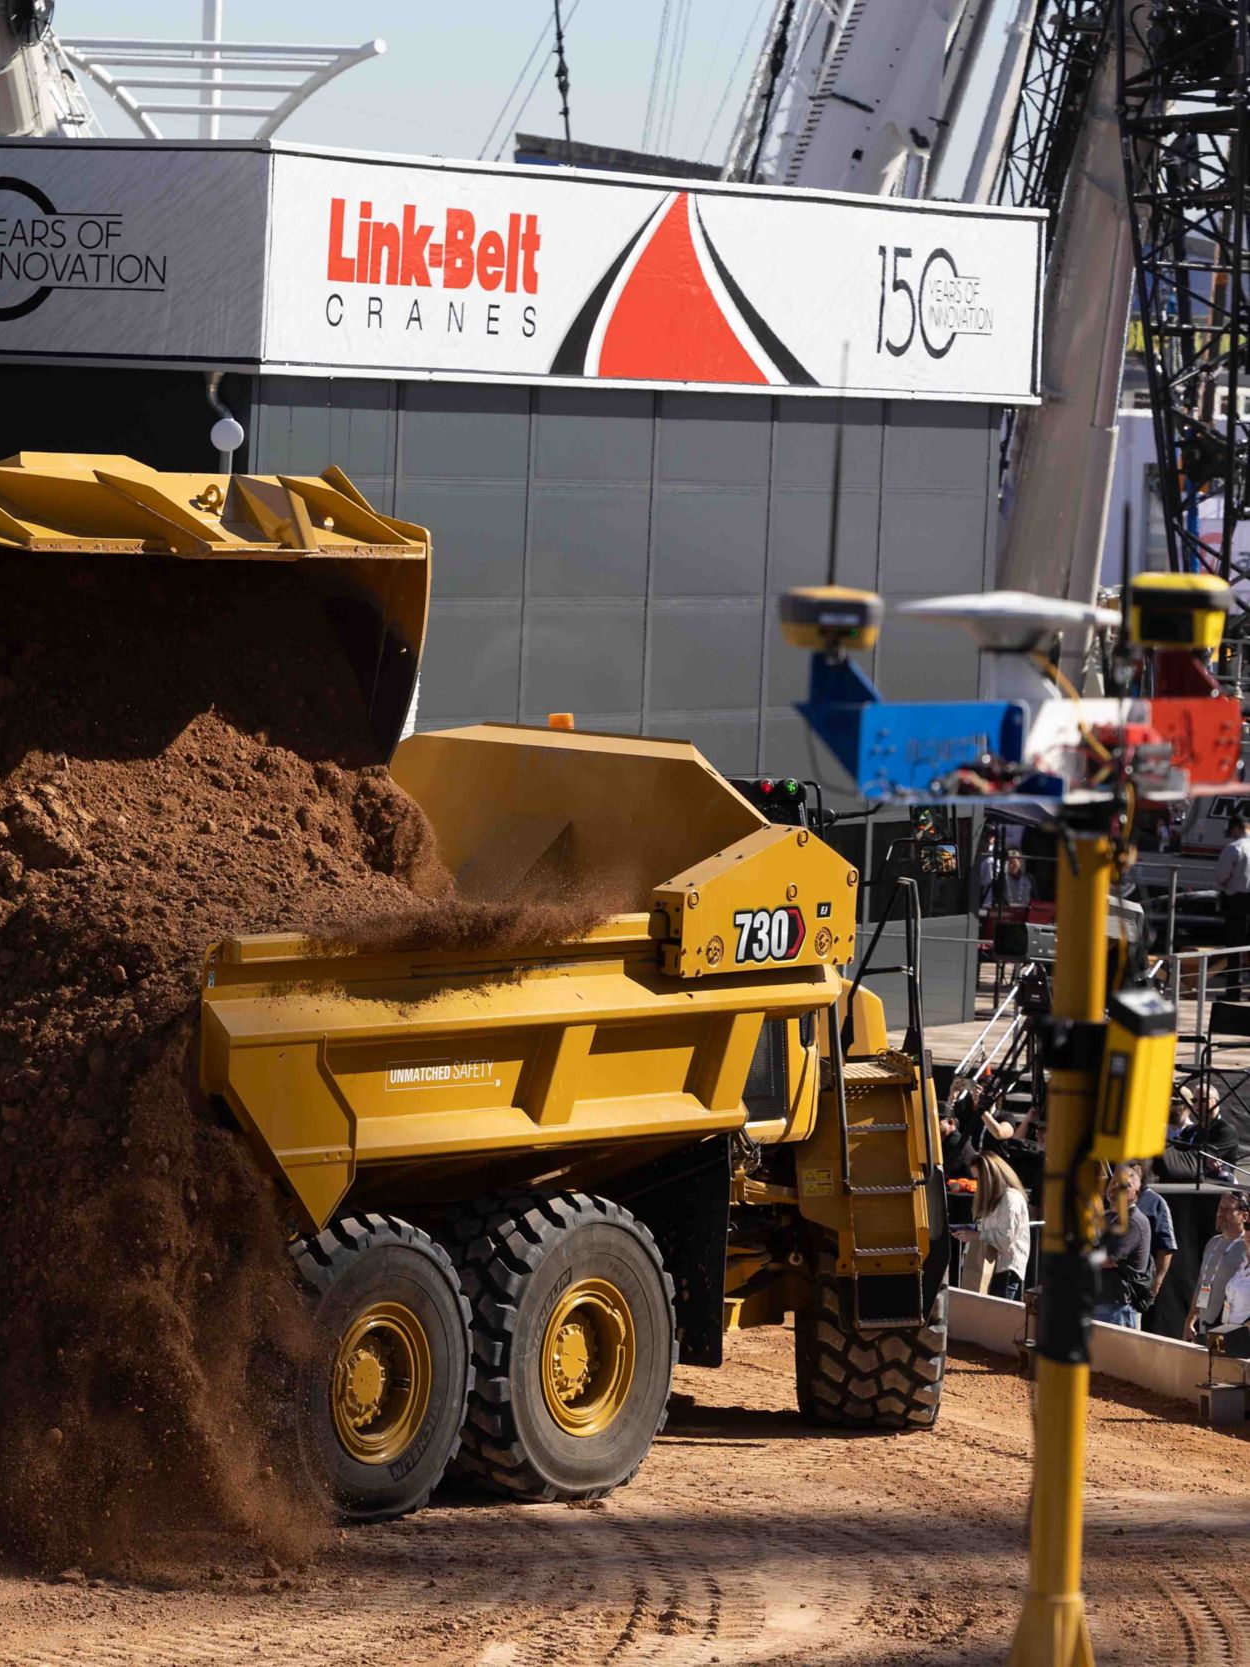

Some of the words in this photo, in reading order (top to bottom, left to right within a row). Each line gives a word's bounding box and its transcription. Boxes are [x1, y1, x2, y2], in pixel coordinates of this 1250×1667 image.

[77, 220, 123, 250] OF
[327, 197, 541, 295] Link-Belt
[877, 245, 958, 359] 150
[929, 279, 962, 304] YEARS
[966, 281, 980, 304] OF
[326, 293, 537, 338] CRANES
[928, 305, 993, 330] INNOVATION
[734, 909, 789, 960] 730
[389, 1065, 450, 1084] UNMATCHED
[452, 1059, 494, 1080] SAFETY
